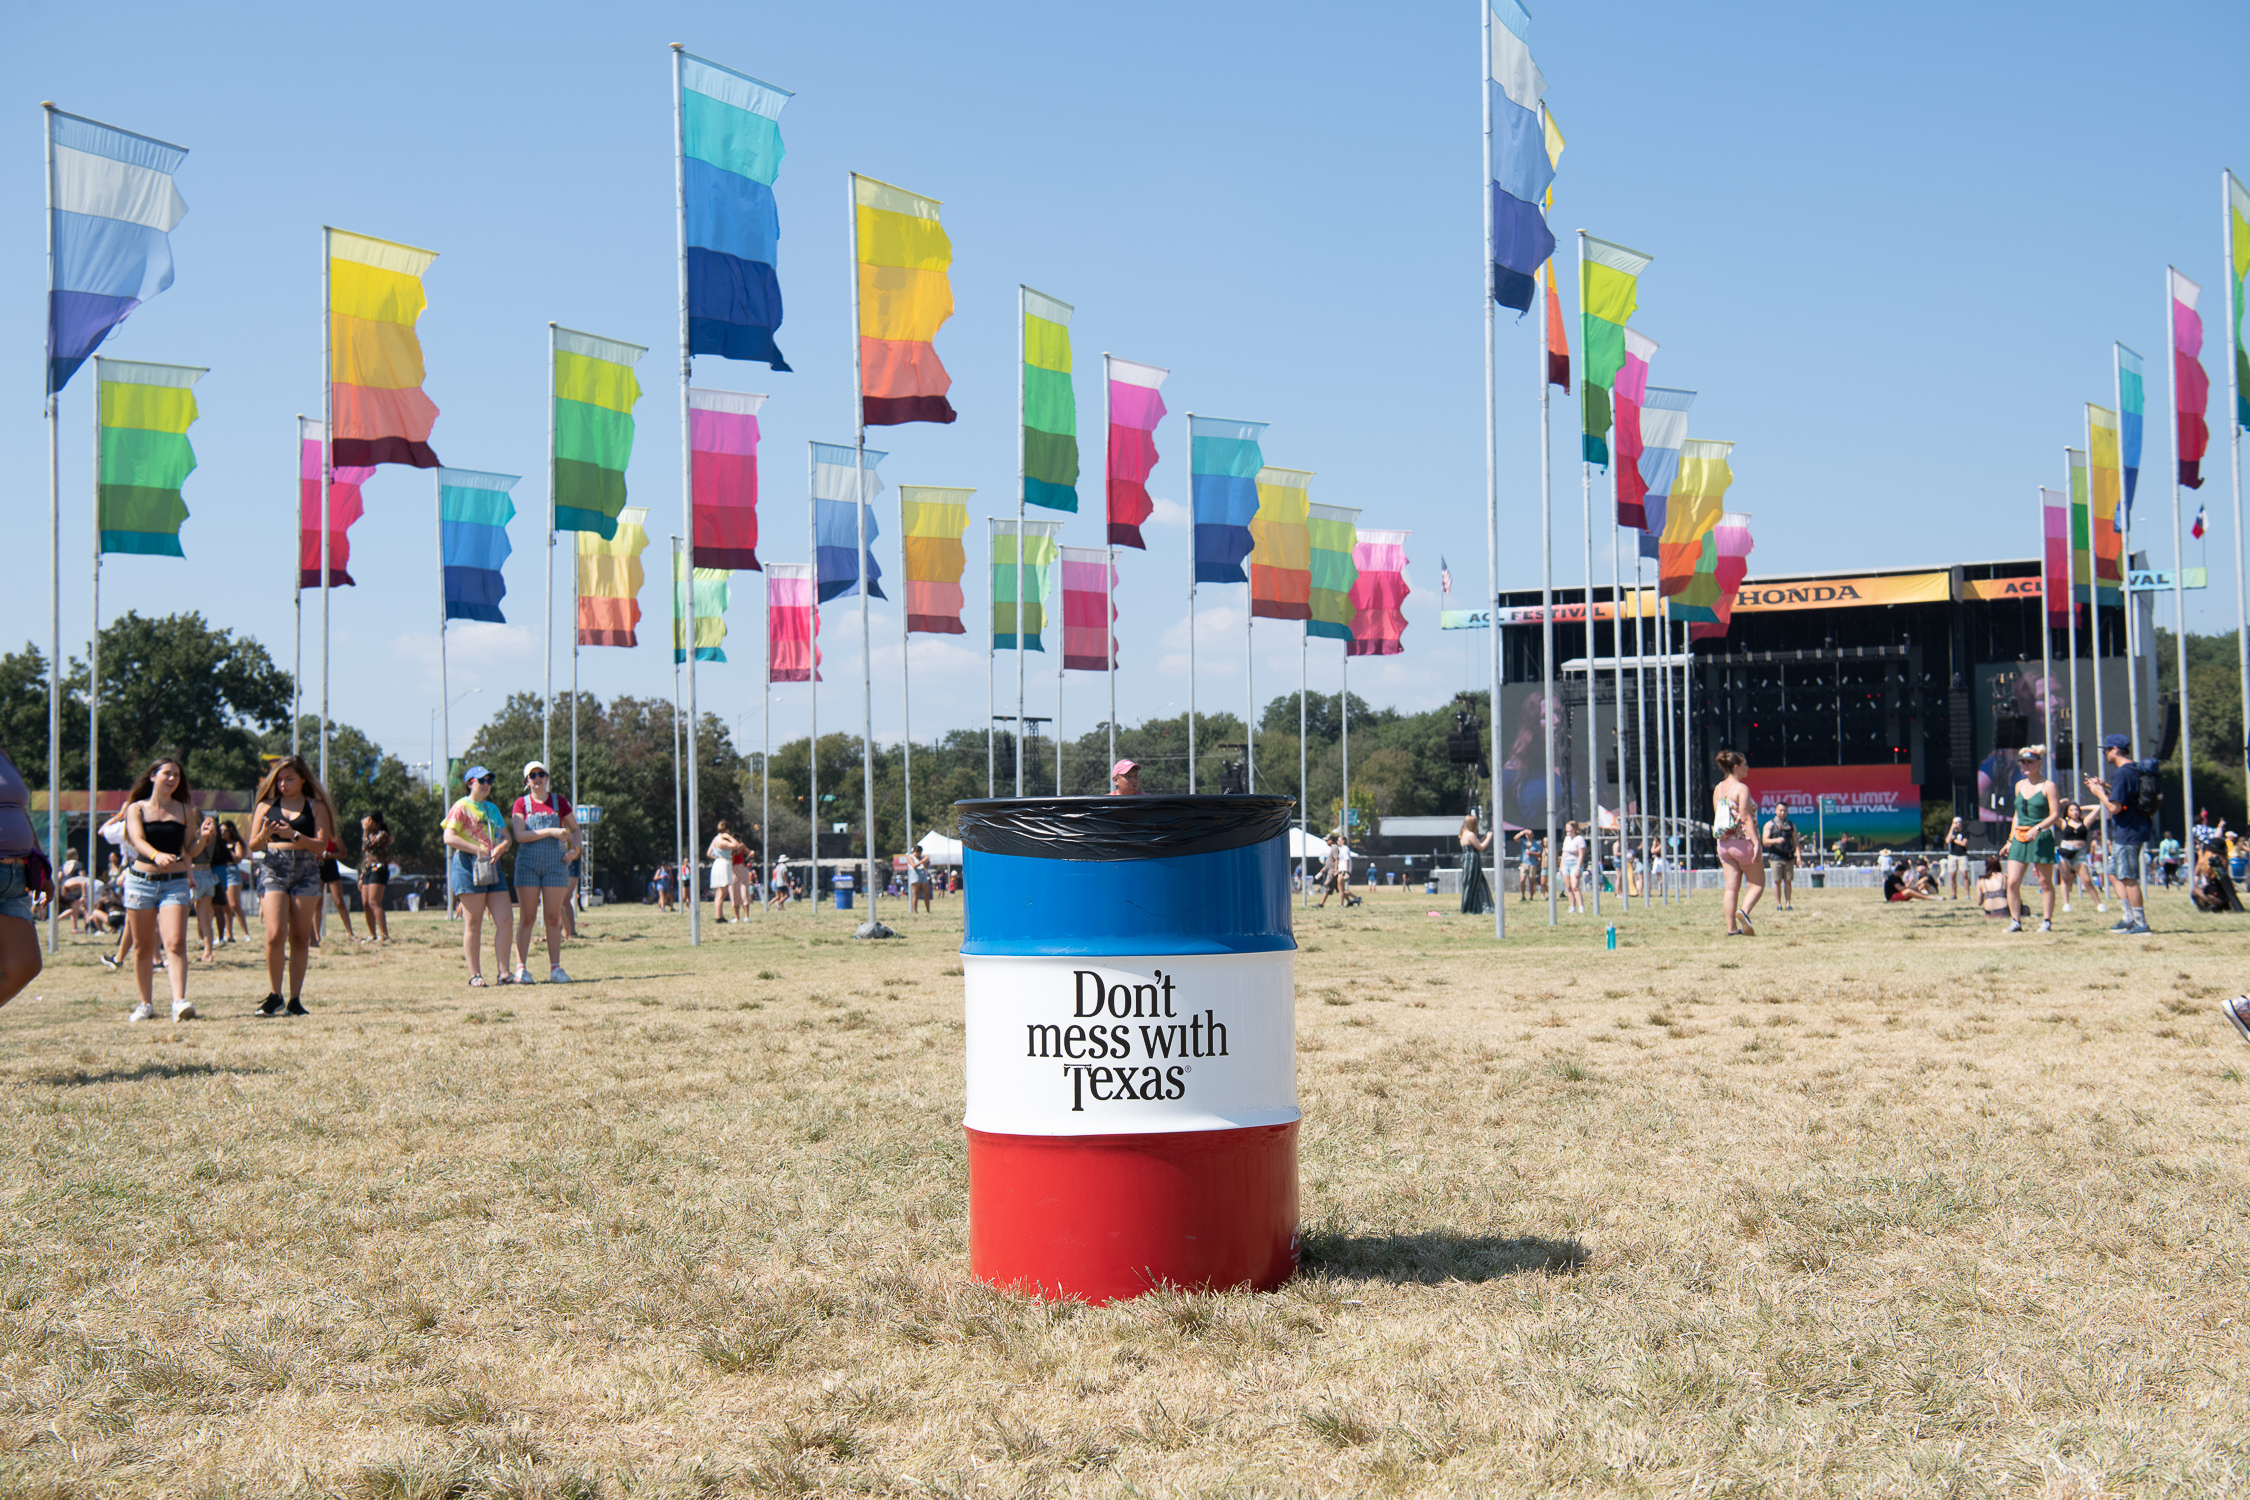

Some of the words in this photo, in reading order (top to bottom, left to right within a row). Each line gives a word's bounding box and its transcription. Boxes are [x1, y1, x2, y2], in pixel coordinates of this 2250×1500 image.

[1736, 585, 1862, 606] HONDA
[1469, 612, 1505, 623] AC
[1761, 806, 1815, 815] MSIC
[1835, 804, 1899, 813] ESTIVAL
[1073, 969, 1178, 1019] Don't
[1026, 1024, 1131, 1059] mess
[1138, 1009, 1229, 1059] with
